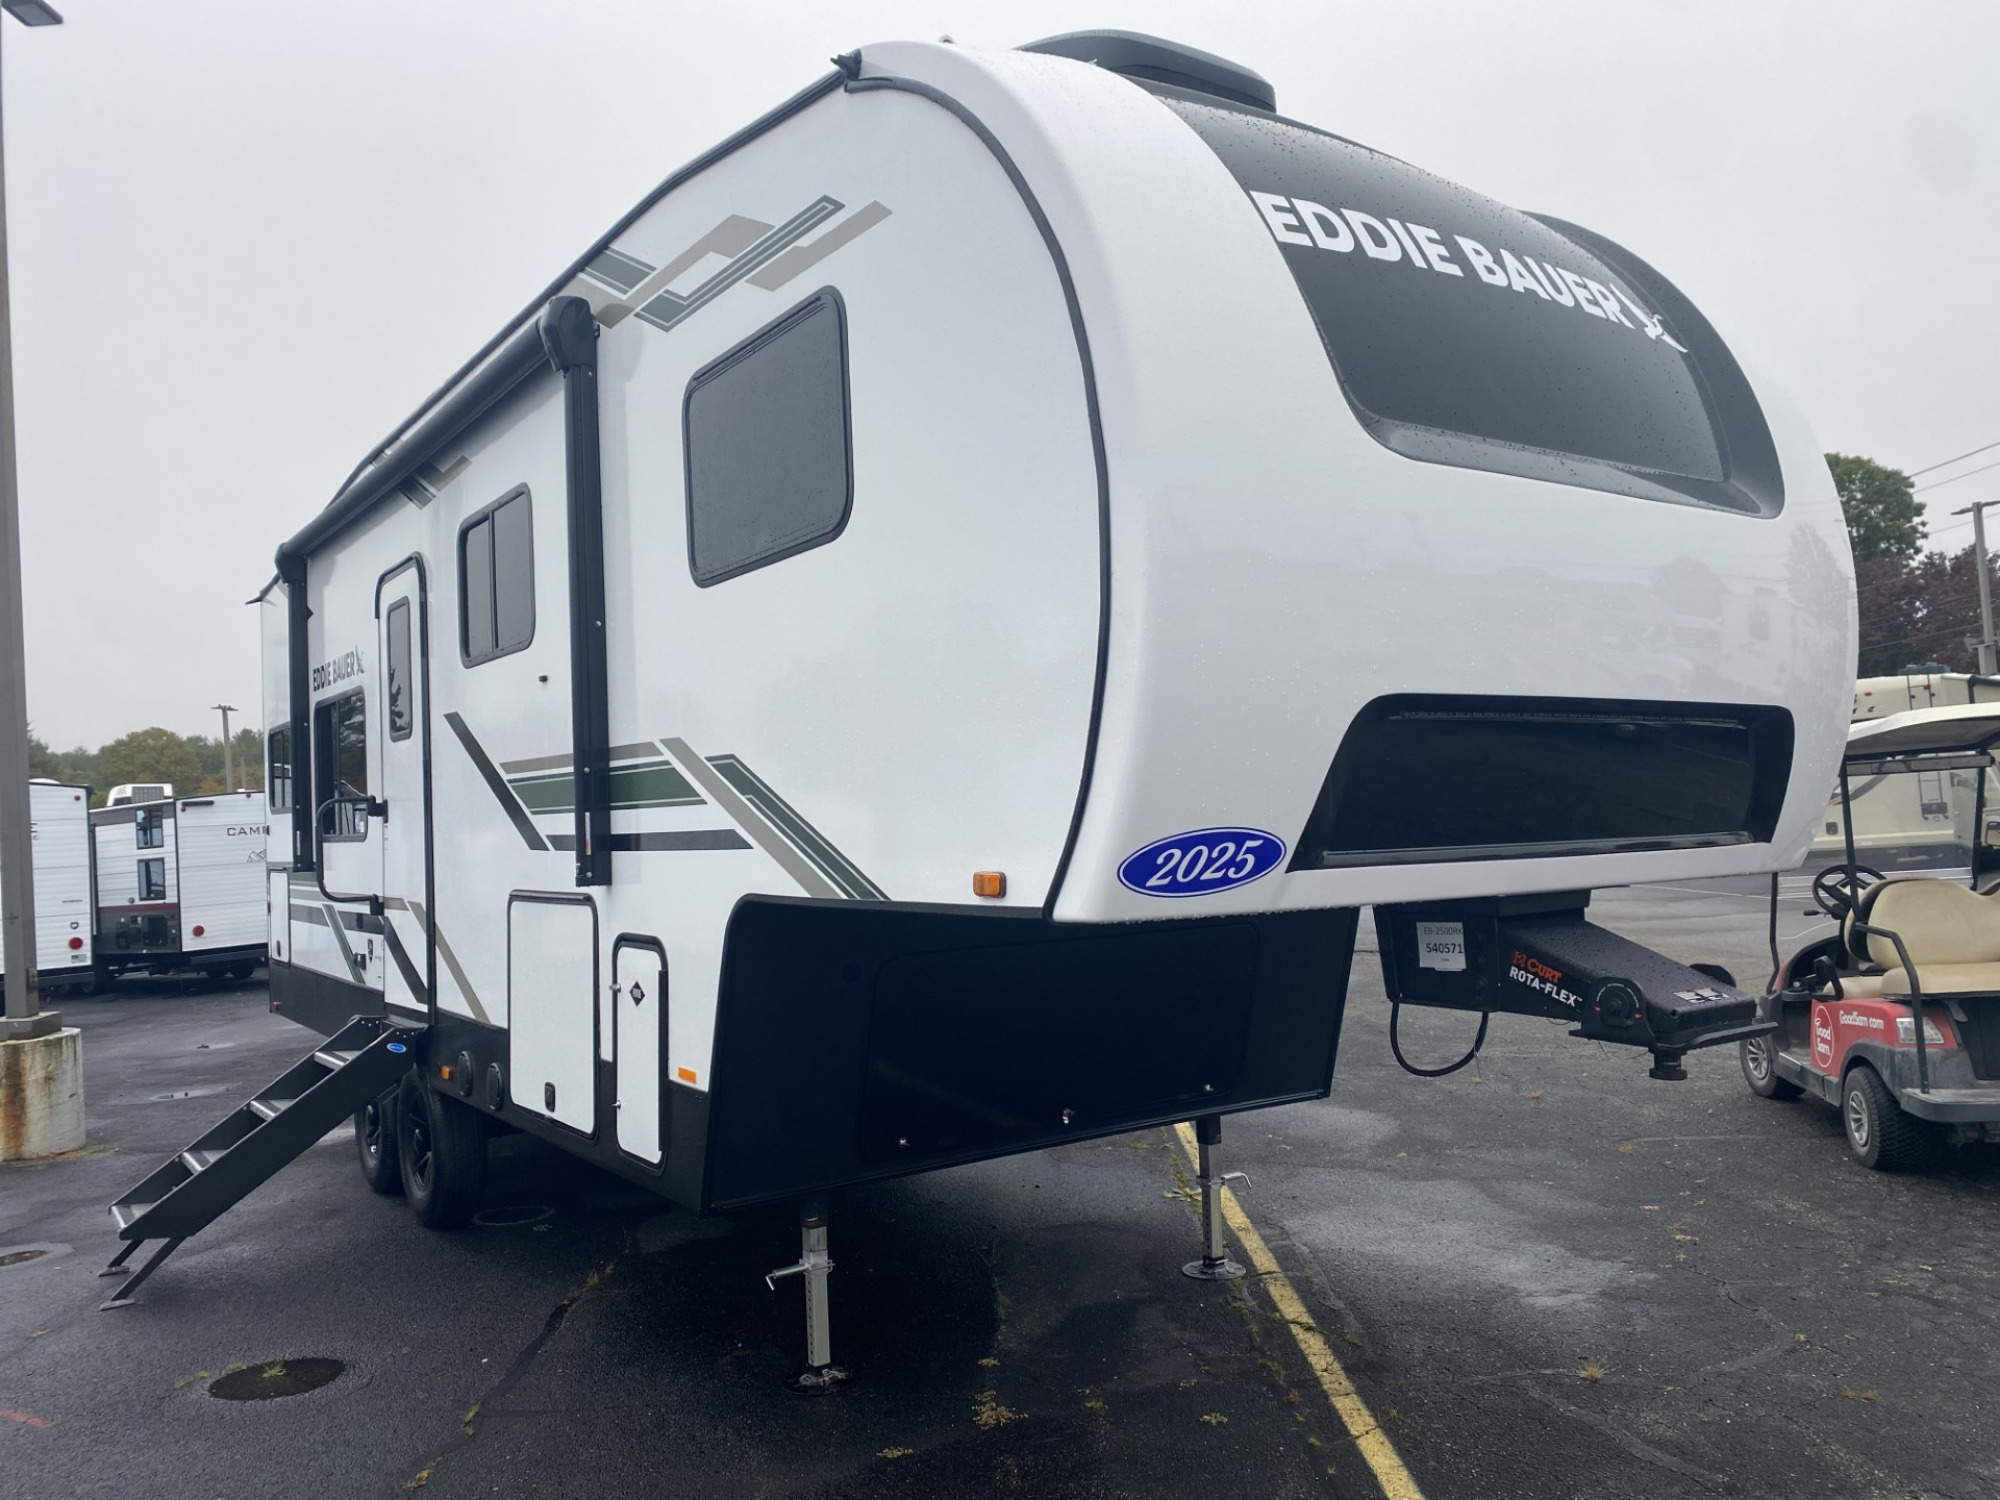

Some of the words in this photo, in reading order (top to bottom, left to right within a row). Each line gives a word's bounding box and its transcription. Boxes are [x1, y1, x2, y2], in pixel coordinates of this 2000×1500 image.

[1249, 190, 1464, 278] EDDIE
[1454, 234, 1635, 329] BAUER
[313, 661, 331, 691] EDDIE
[333, 651, 355, 683] BAUER
[1145, 839, 1264, 887] 2025
[1426, 942, 1464, 954] 540571
[1527, 958, 1563, 983] CURT
[1815, 1023, 1831, 1040] Good
[1817, 1038, 1831, 1055] Sam
